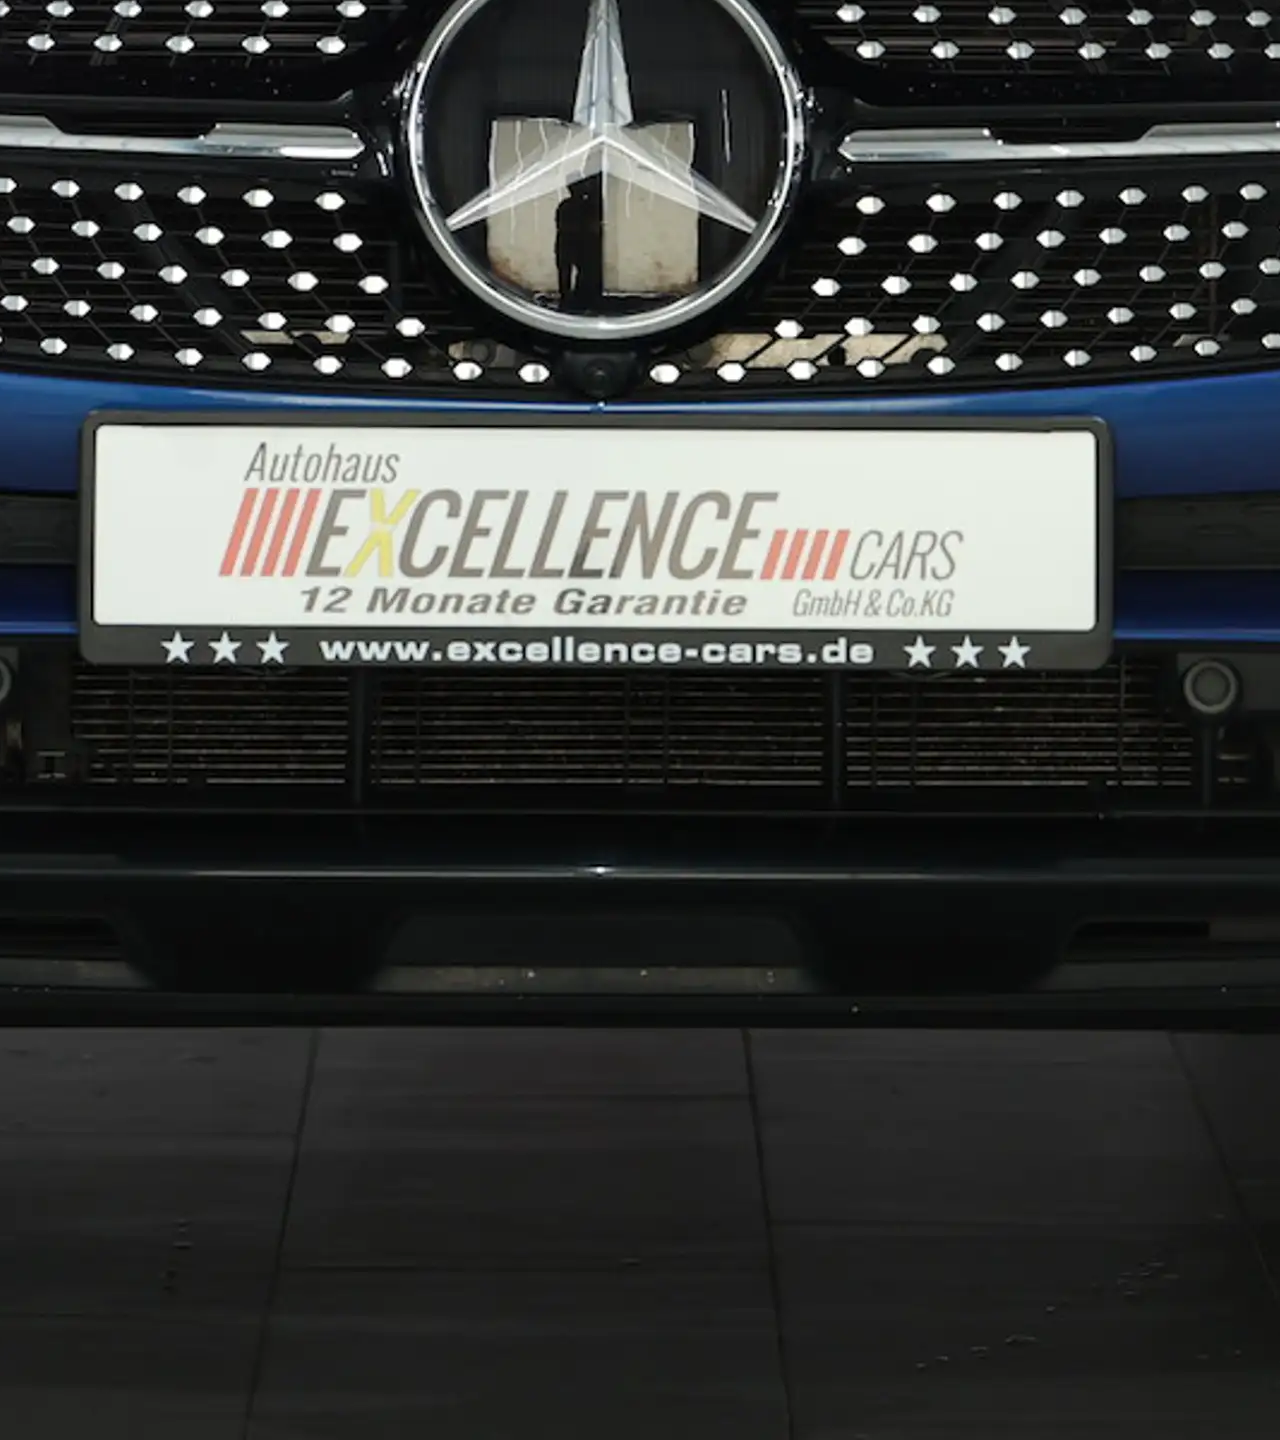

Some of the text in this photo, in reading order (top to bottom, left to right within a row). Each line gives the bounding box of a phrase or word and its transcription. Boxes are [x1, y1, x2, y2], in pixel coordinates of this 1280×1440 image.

[243, 442, 401, 484] Autohaus
[304, 487, 964, 581] EXCELLENCE CARS
[300, 585, 748, 617] 12 Monate Garantie
[319, 636, 875, 664] www.excellence-cars.de
